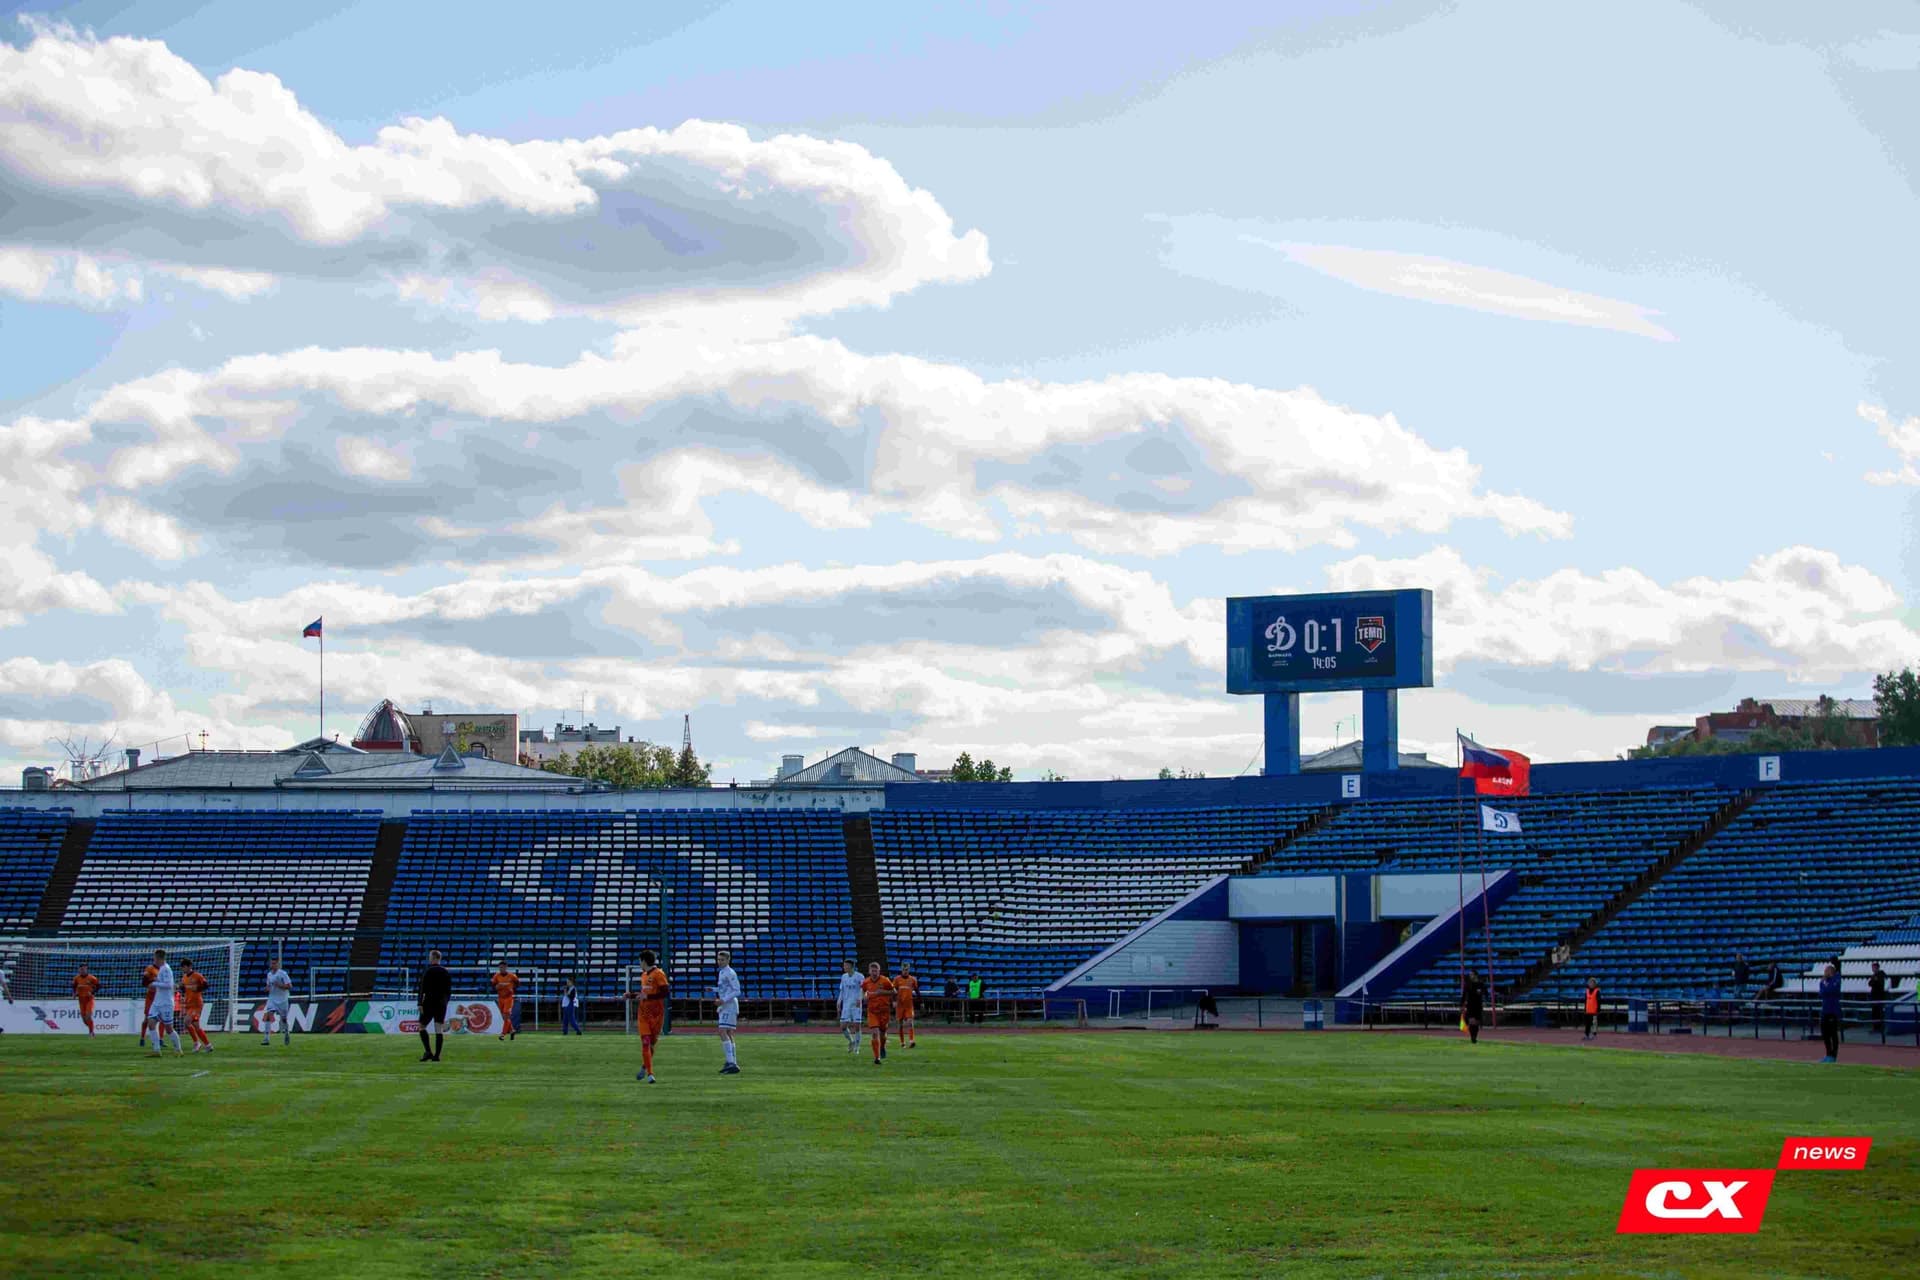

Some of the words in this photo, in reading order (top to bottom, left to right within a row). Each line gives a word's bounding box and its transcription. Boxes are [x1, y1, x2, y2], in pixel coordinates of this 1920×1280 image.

[1304, 617, 1342, 654] 0:1
[1358, 626, 1383, 640] ТЕМП
[1312, 656, 1336, 670] 14:05
[1766, 761, 1773, 776] F
[1347, 779, 1355, 793] E
